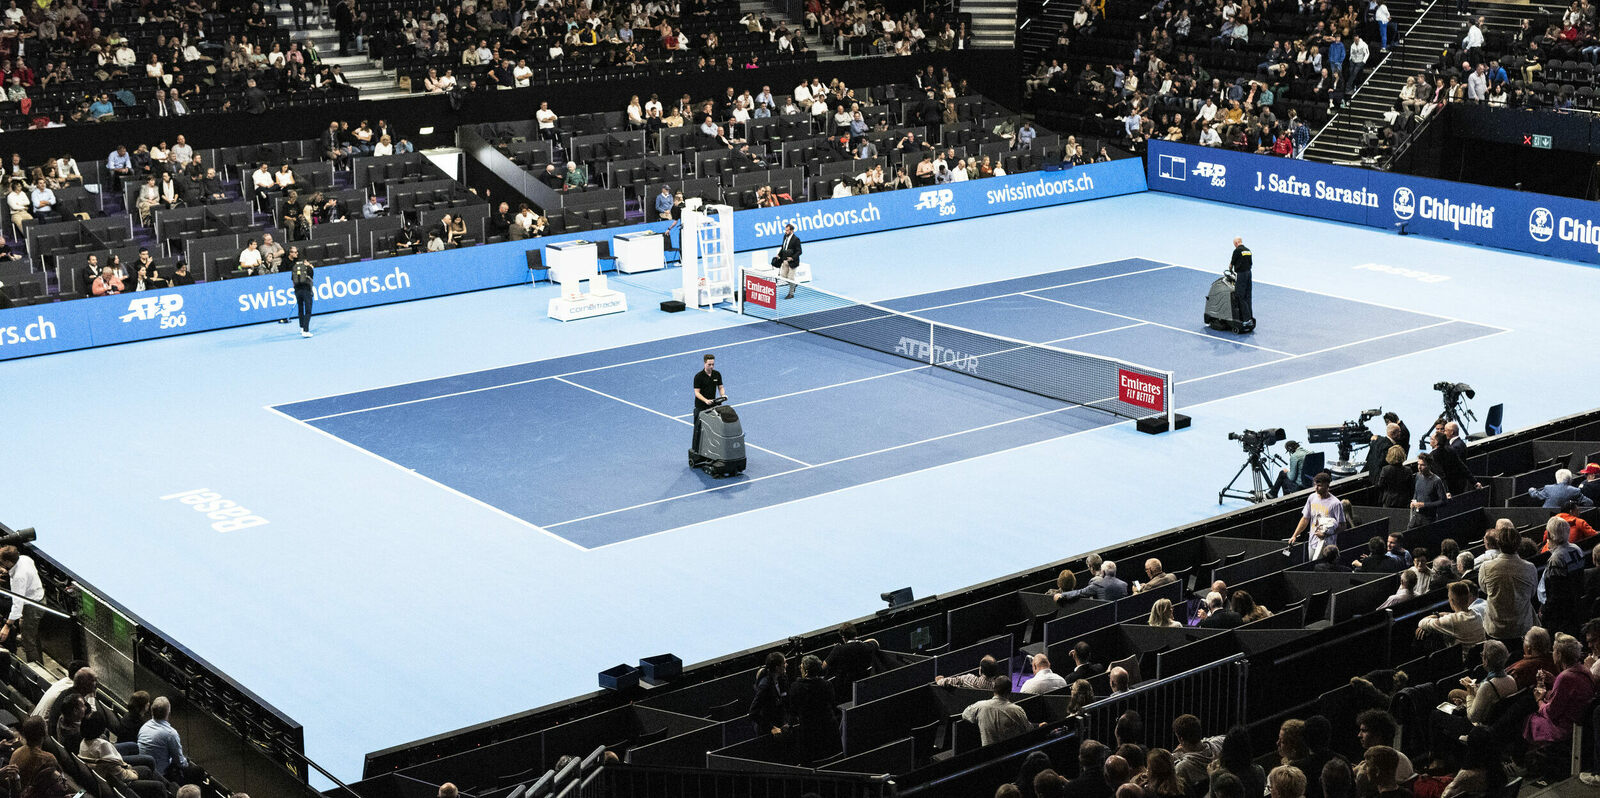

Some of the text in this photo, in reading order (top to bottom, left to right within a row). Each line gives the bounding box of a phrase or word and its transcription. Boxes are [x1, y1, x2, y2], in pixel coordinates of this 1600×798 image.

[1192, 161, 1226, 178] ATP
[1210, 178, 1226, 187] 500
[914, 189, 954, 210] ATP
[987, 172, 1094, 205] swissindoors.ch
[1254, 171, 1379, 208] J. Safra Sarasin
[754, 202, 880, 238] swissindoors.ch
[939, 203, 956, 216] 500
[1419, 195, 1494, 231] Chiquita
[238, 267, 411, 312] swissdoors.ch
[747, 280, 775, 296] Emirates
[118, 293, 184, 323] ATP
[160, 314, 187, 330] 500
[894, 336, 979, 374] ATP TOUR
[1121, 374, 1161, 396] Emirates
[1136, 390, 1155, 405] BETTER
[159, 487, 271, 533] Basel
